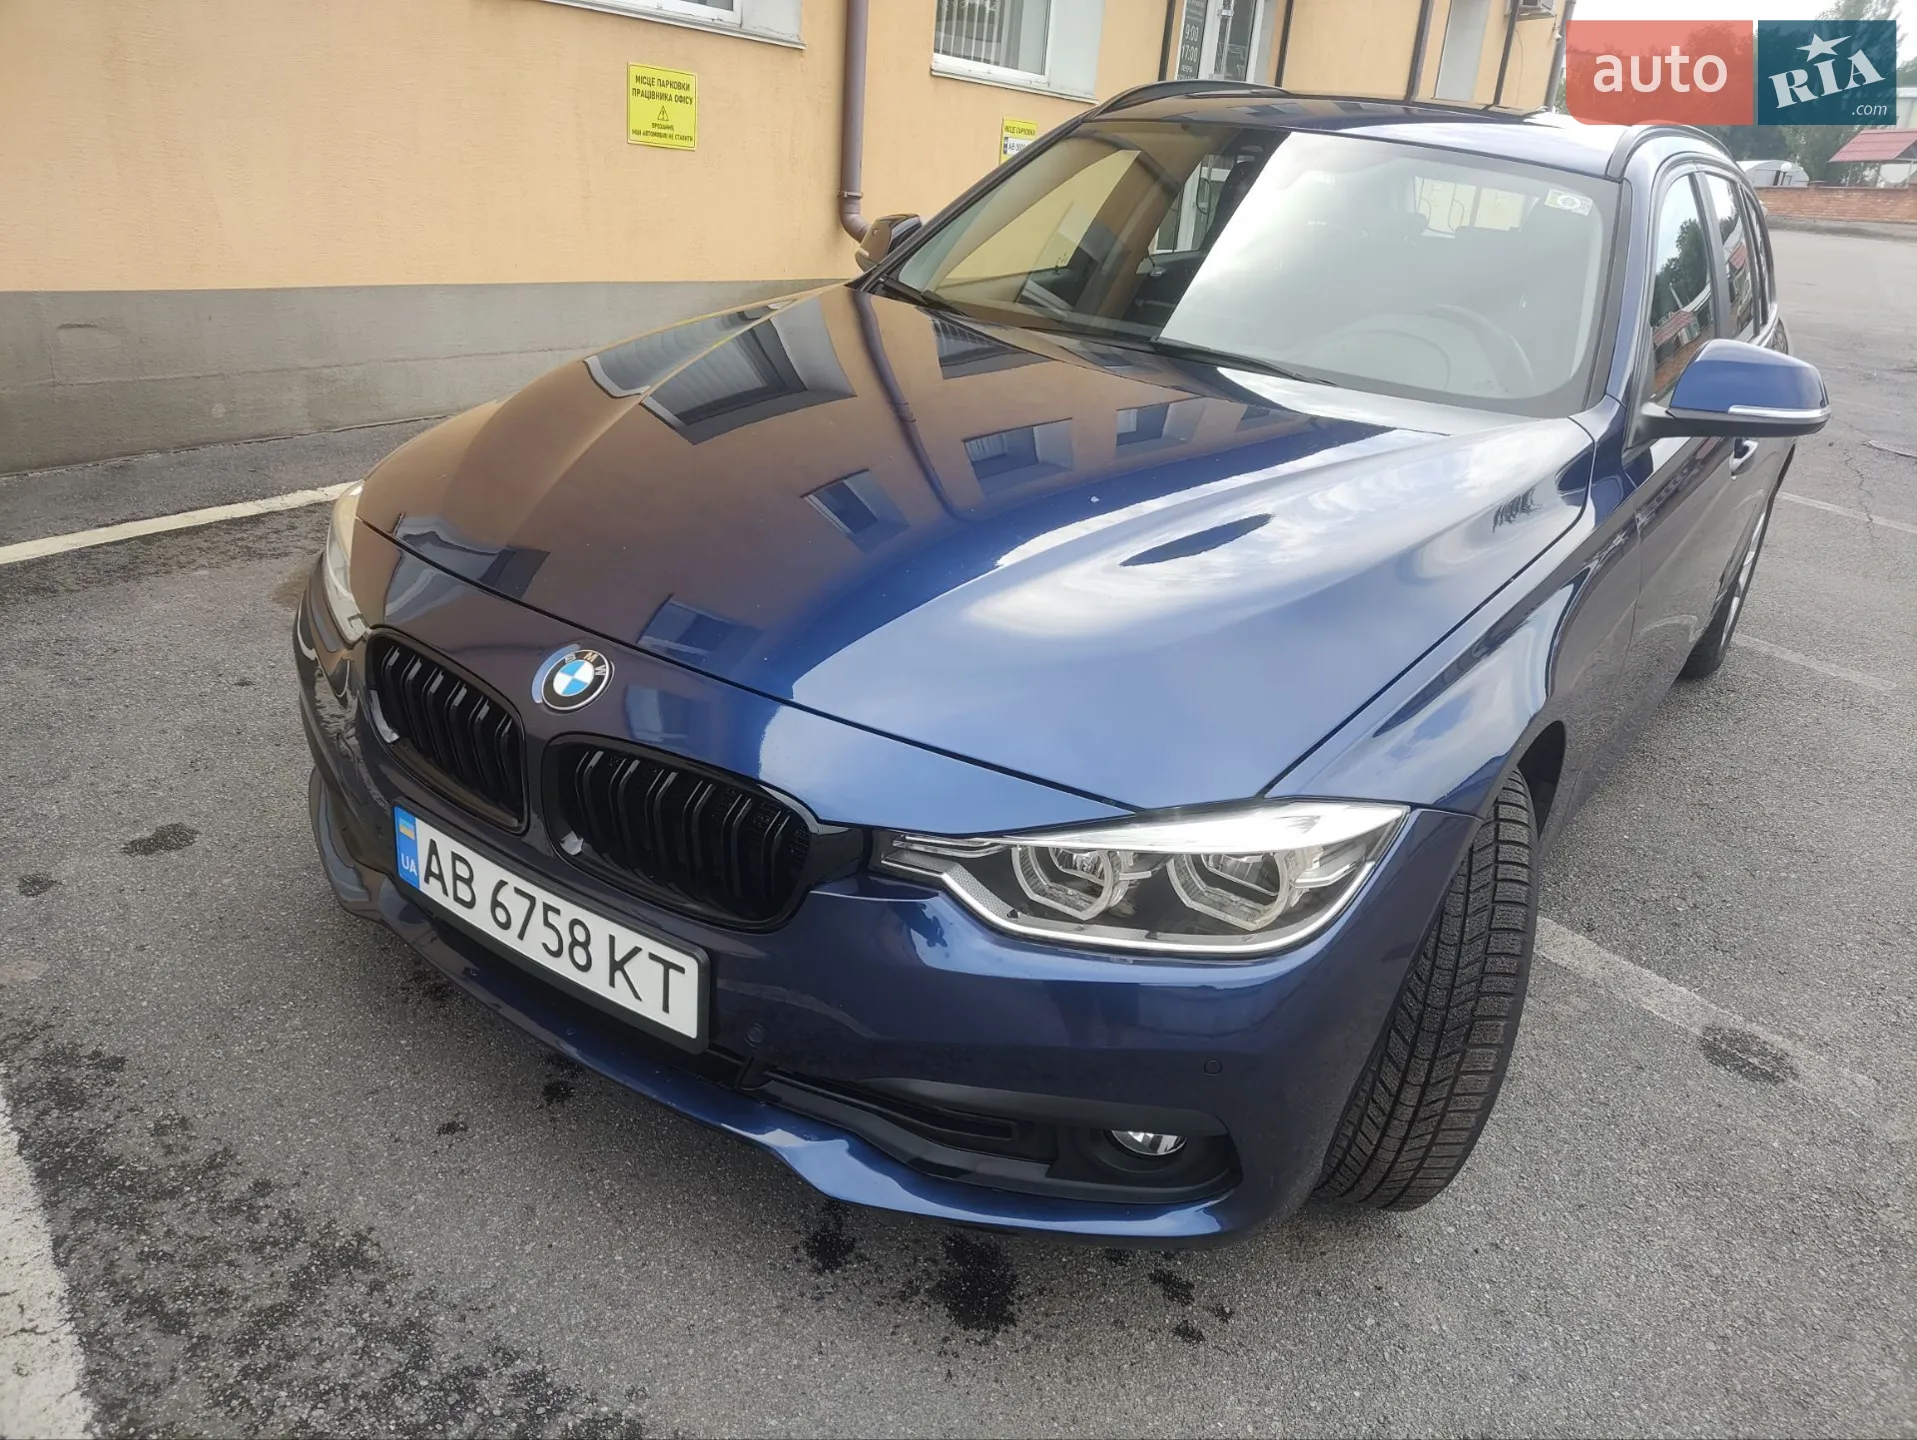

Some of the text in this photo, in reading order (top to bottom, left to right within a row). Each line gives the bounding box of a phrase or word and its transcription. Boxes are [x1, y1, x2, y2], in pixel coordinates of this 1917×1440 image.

[635, 75, 691, 91] МІСЦЕ ПАРКОВКИ
[632, 88, 694, 105] ПРАЦІВНИКА ОФІСУ
[564, 651, 607, 676] BMW
[400, 855, 418, 877] UA
[423, 838, 686, 1014] AB 6758 KT
